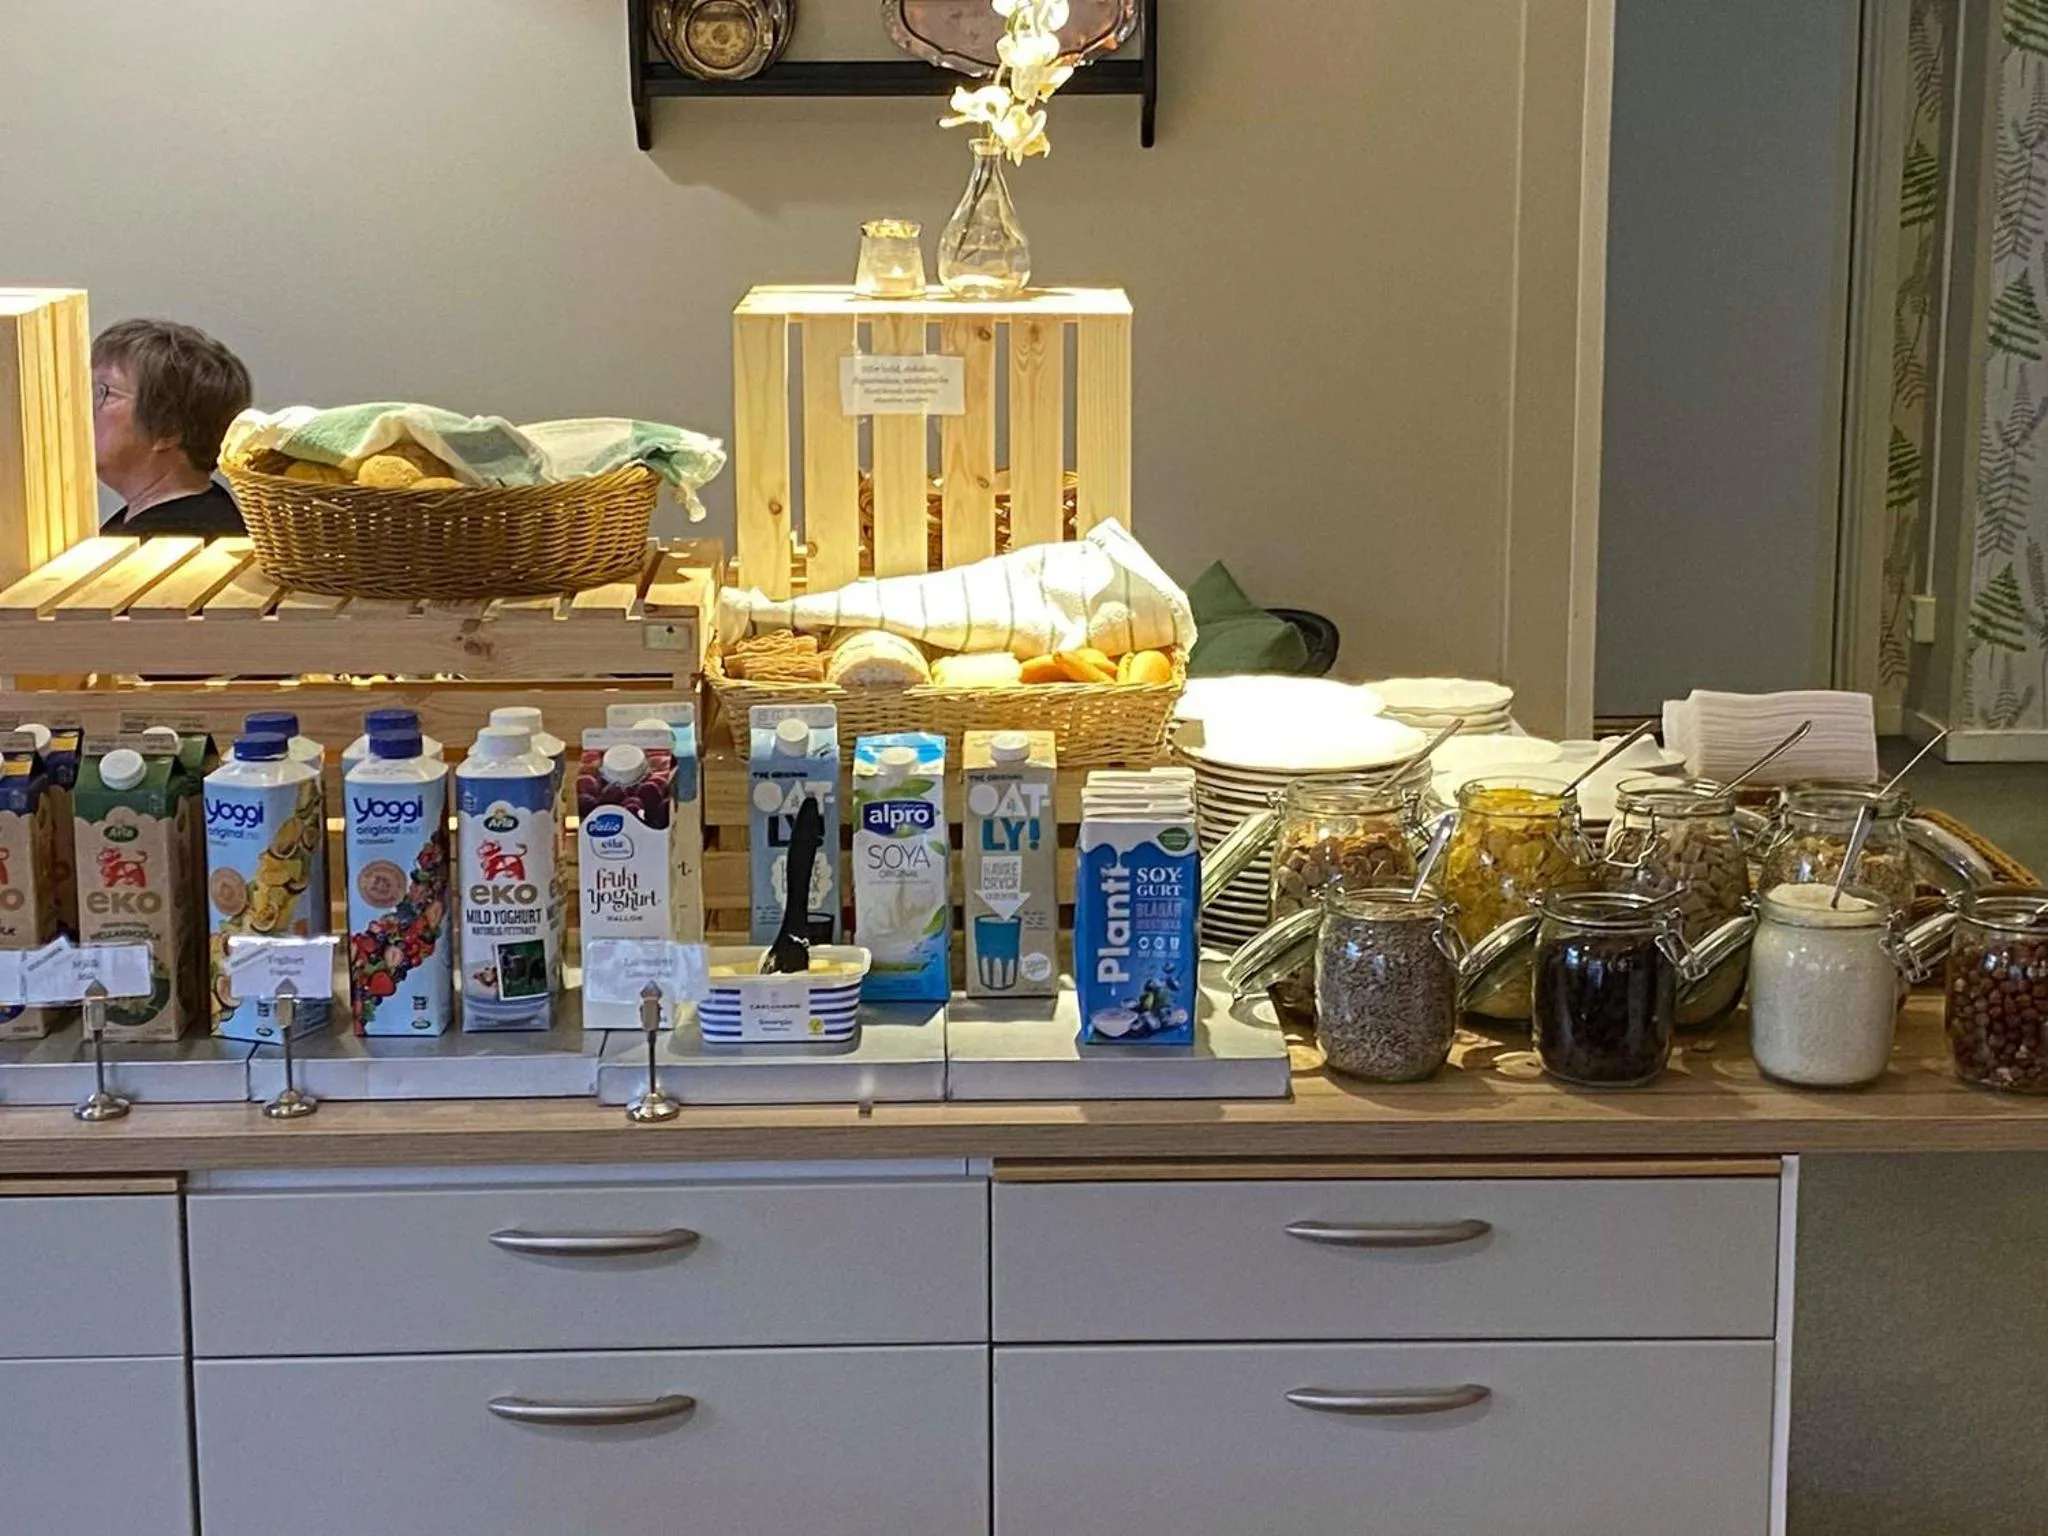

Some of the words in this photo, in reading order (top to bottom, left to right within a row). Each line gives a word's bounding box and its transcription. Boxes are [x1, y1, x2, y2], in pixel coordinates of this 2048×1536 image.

[206, 797, 264, 829] yoggi
[353, 794, 424, 824] yoggi
[869, 804, 929, 829] alpro
[356, 825, 400, 837] original
[488, 818, 516, 830] Arla
[983, 816, 1041, 851] LY!
[868, 844, 931, 869] SOYA
[596, 867, 638, 891] frukt
[1136, 866, 1182, 883] SOY-
[587, 888, 657, 915] yoghurt
[1136, 884, 1182, 896] GURT
[466, 909, 491, 924] MILD
[494, 908, 542, 924] YOGHURT
[1097, 865, 1130, 982] Planti
